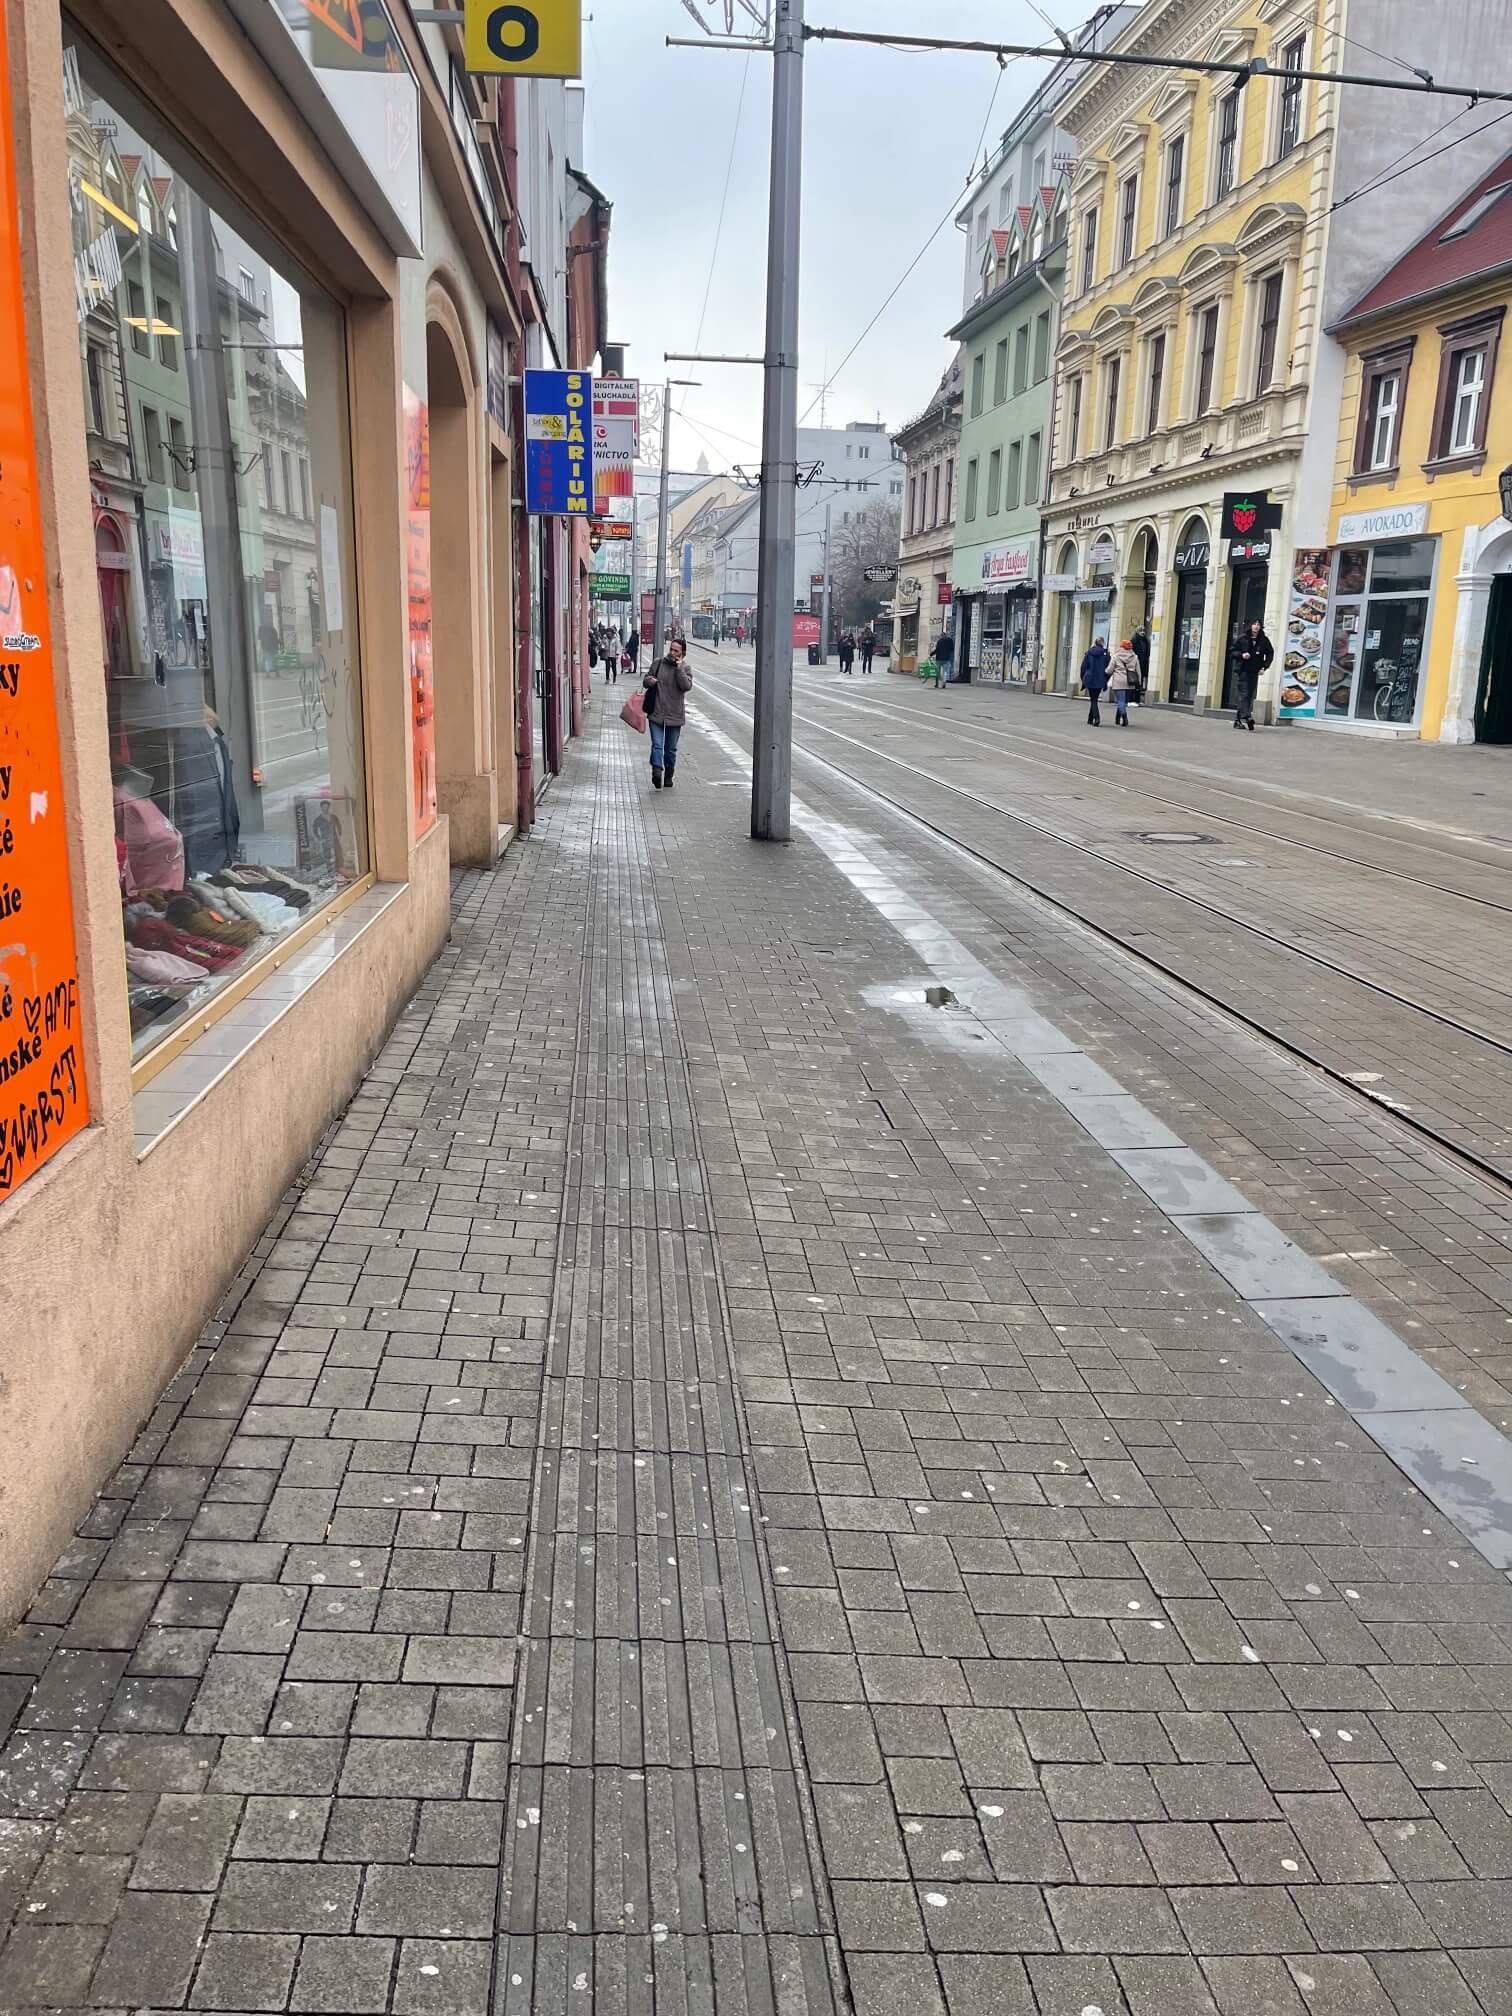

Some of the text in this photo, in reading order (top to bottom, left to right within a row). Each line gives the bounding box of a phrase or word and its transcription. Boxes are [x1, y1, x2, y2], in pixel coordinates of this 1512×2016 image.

[565, 374, 588, 512] SOLÁRIUM
[593, 450, 629, 459] NICTVO
[1362, 511, 1413, 533] AVOKADO
[598, 575, 628, 583] GOVINDA
